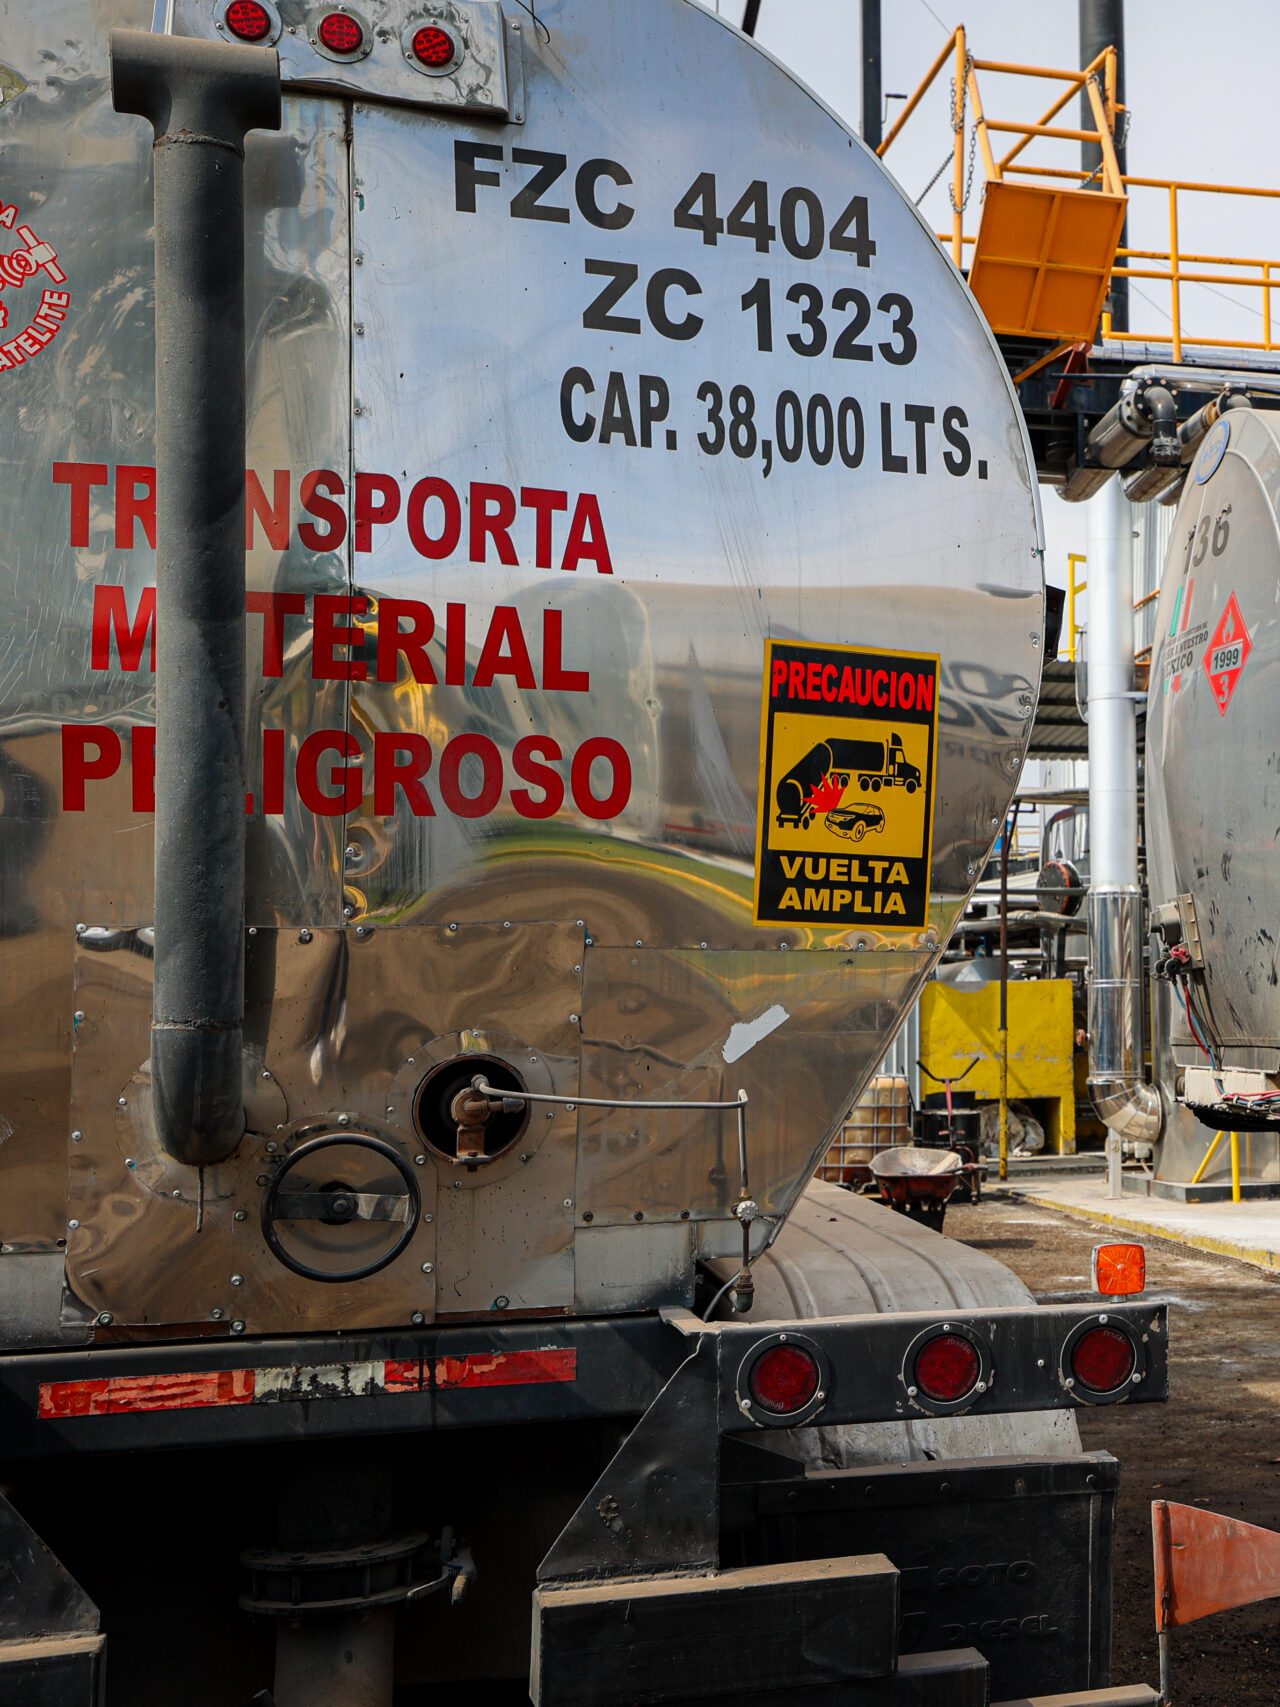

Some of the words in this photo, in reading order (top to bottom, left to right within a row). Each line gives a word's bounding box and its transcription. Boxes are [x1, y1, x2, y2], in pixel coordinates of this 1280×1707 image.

[454, 140, 635, 231] FZC
[673, 172, 877, 268] 4404
[582, 258, 703, 341] ZC
[741, 277, 918, 366] 1323
[559, 366, 678, 451] CAP.
[696, 381, 865, 478] 38,000
[880, 402, 989, 480] LTS.
[53, 461, 614, 575] TRNSPORTA
[91, 584, 591, 693] MTERIAL
[1213, 647, 1239, 670] 1999
[771, 659, 934, 712] PRECAUCION
[1218, 674, 1229, 704] 3
[61, 724, 632, 820] PIGROSO
[779, 855, 910, 885] VUELTA
[777, 886, 906, 915] AMPLIA
[936, 1560, 1038, 1588] SOTO
[939, 1614, 1058, 1645] DIESEL
